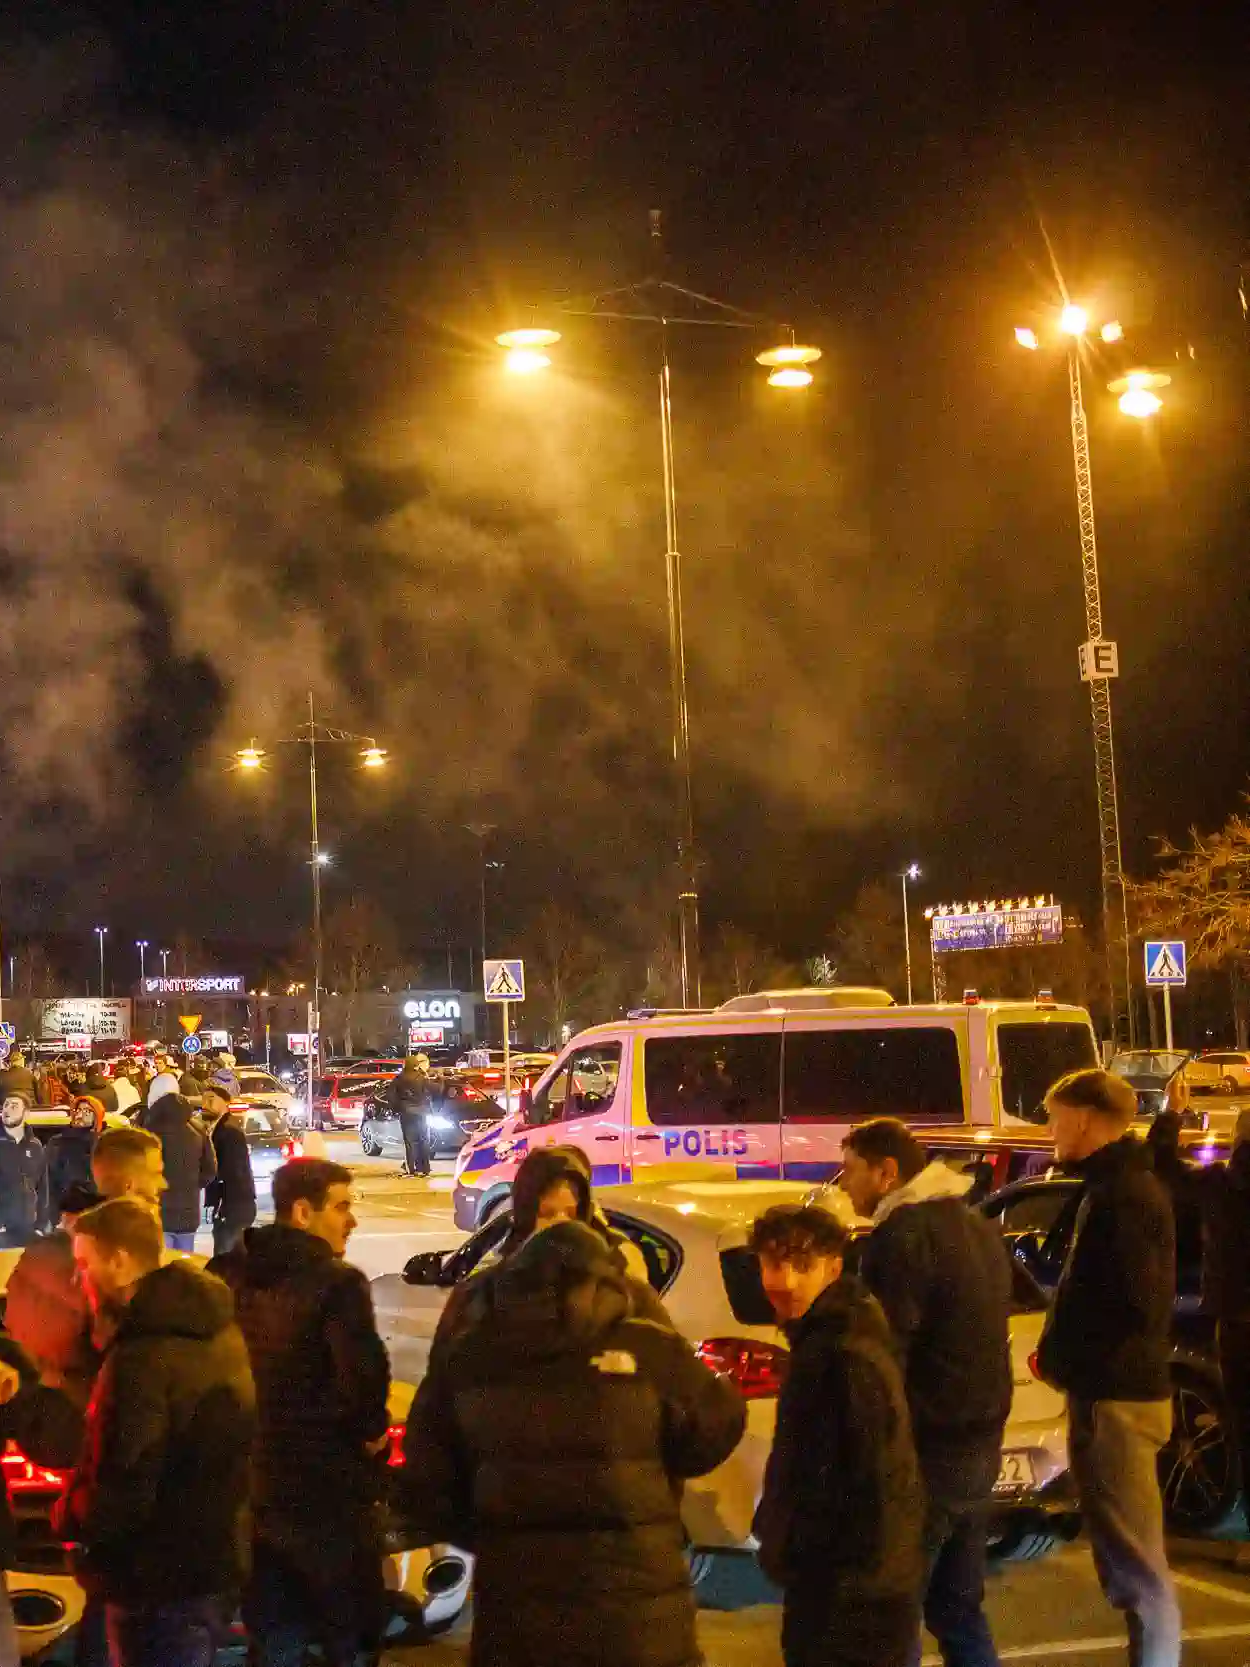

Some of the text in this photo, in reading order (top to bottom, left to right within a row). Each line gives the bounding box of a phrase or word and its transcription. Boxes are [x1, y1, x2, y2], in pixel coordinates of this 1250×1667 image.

[1094, 645, 1113, 672] E
[159, 979, 241, 992] INTERSPORT
[664, 1129, 748, 1156] POLIS
